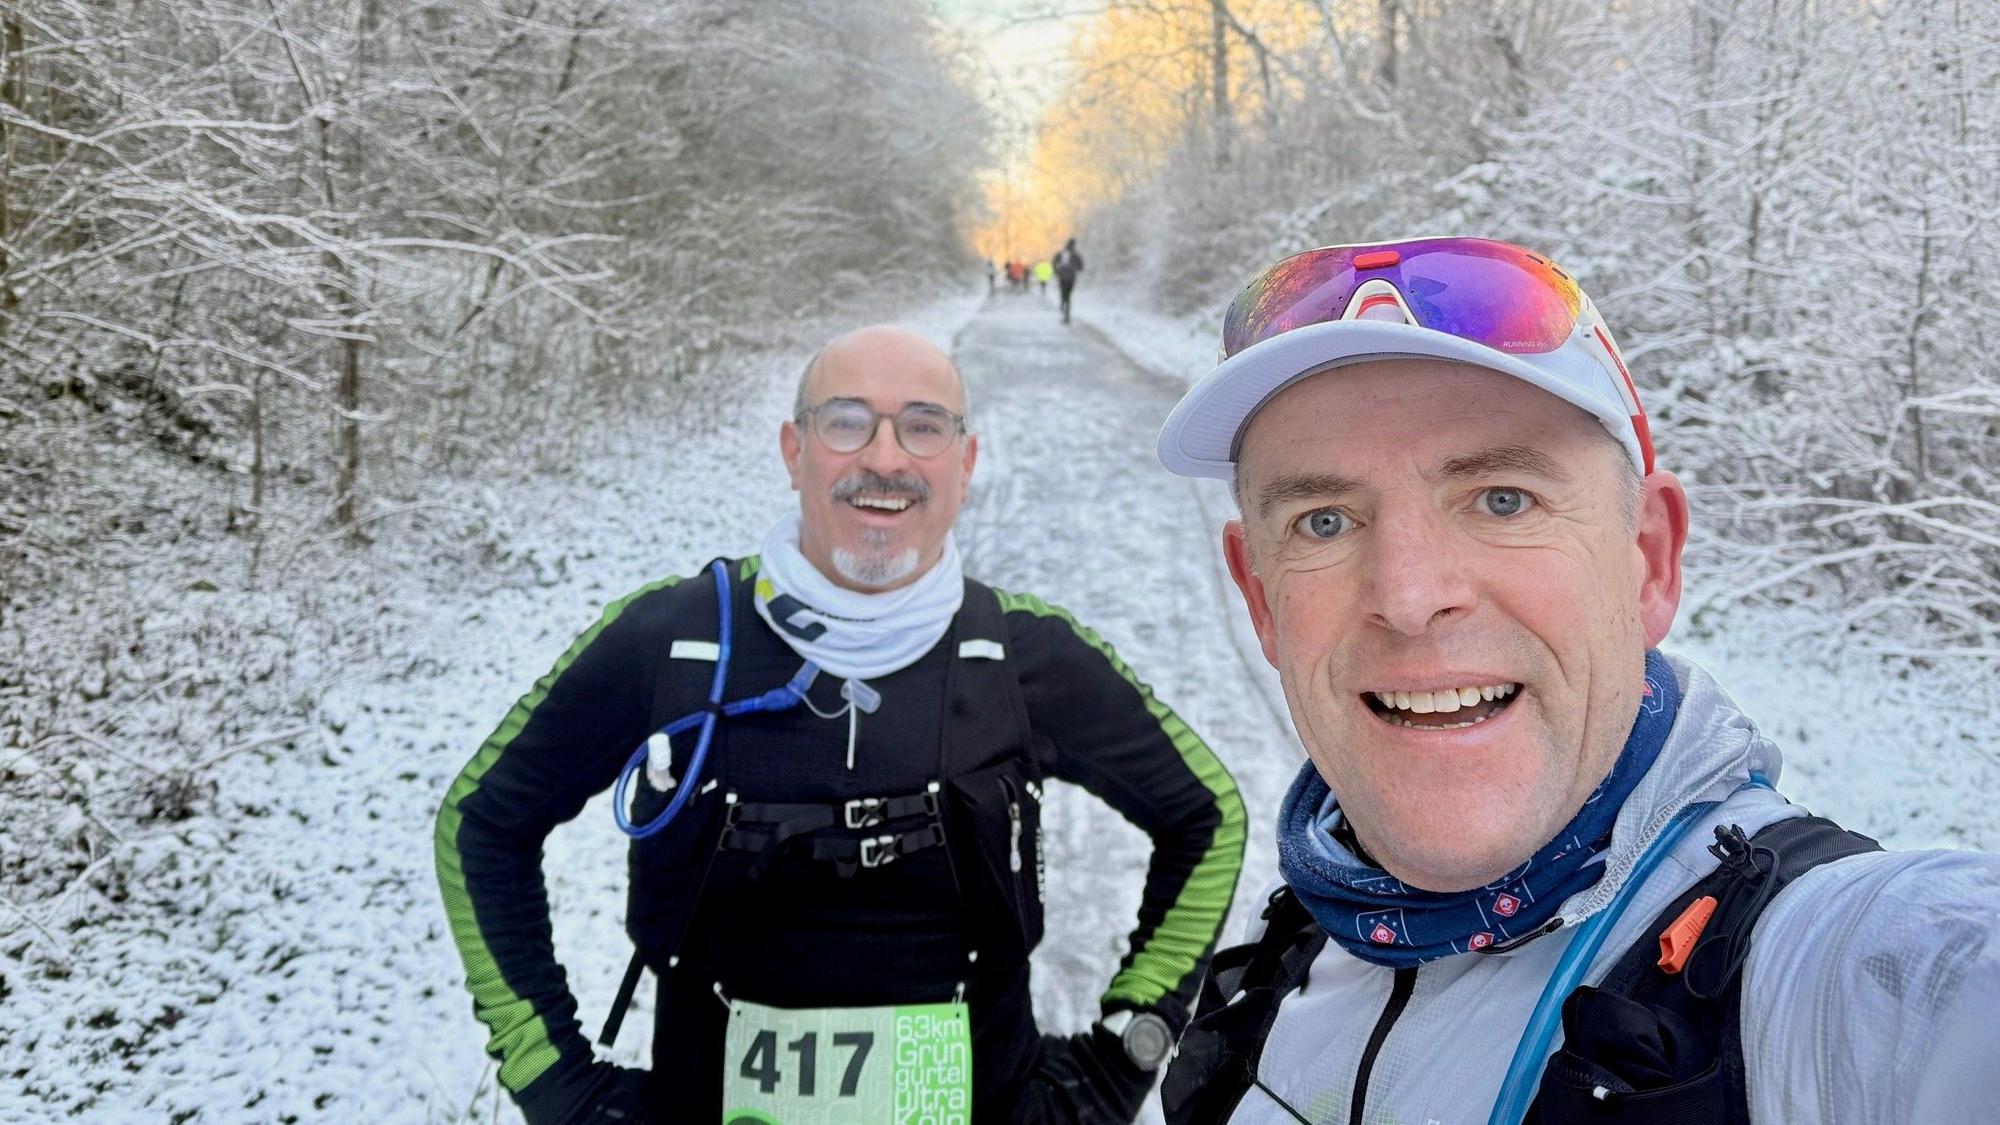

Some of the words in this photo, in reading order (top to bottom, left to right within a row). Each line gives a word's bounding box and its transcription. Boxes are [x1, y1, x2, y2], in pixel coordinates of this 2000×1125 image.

[1503, 340, 1536, 348] RUNNING
[896, 1014, 964, 1040] 63km
[740, 1029, 874, 1097] 417
[896, 1038, 966, 1067] Grün
